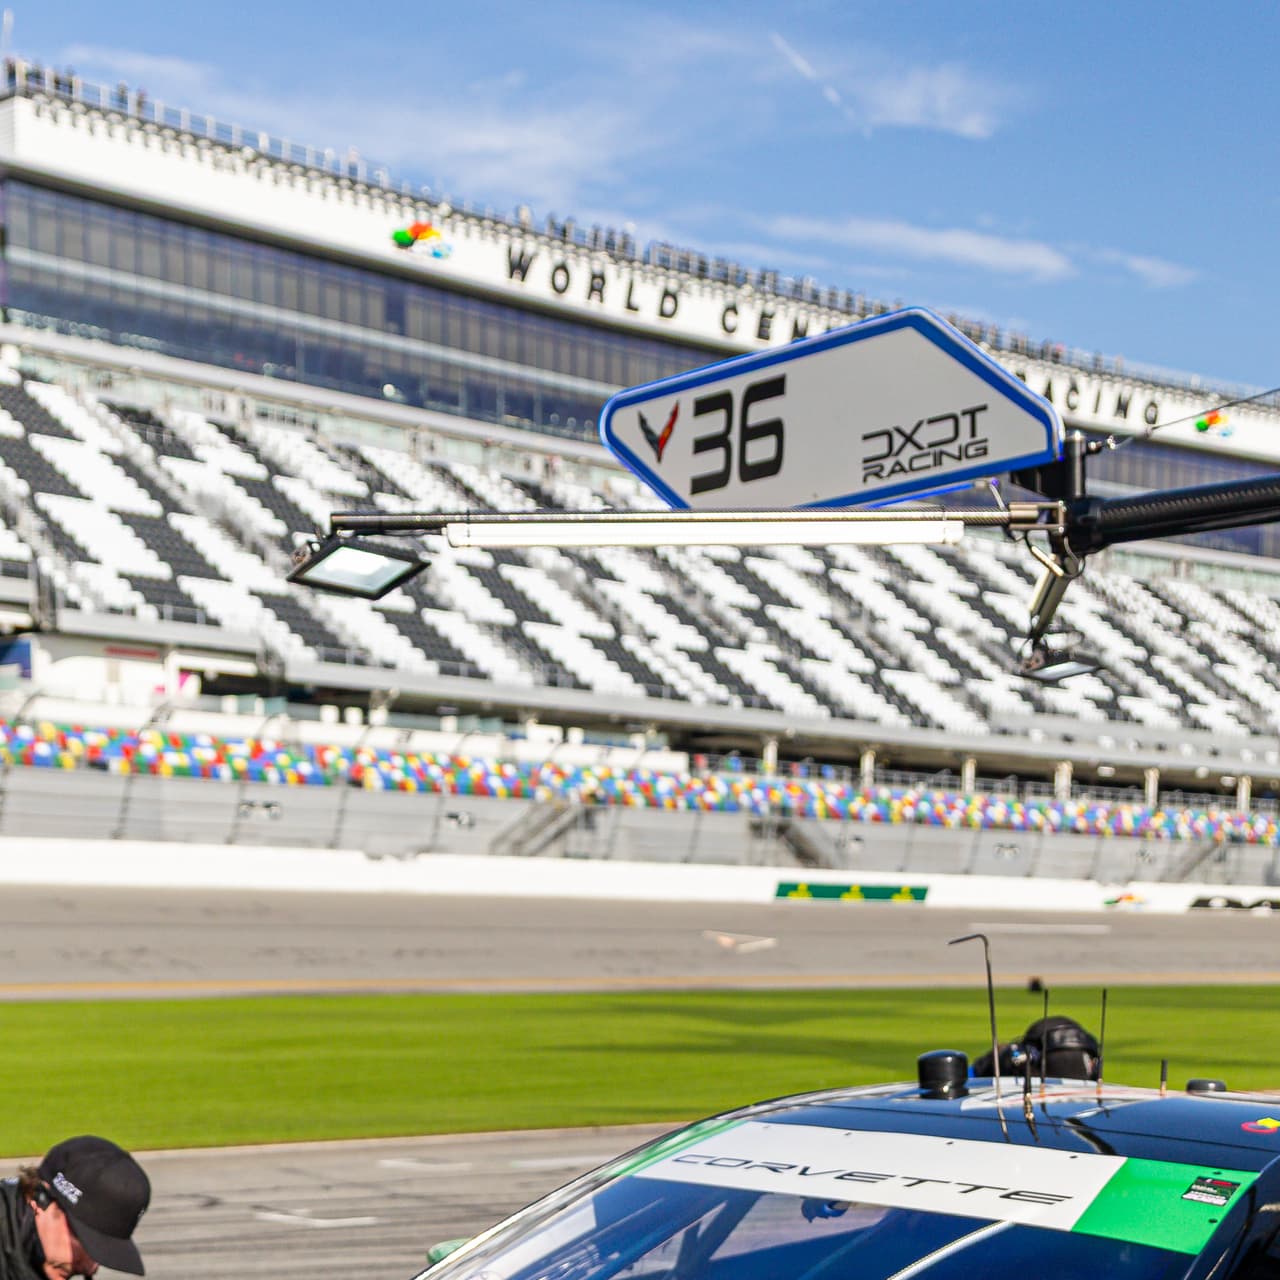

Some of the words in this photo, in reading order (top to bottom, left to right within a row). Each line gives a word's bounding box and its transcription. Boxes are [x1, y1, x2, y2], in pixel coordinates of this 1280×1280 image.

[508, 247, 677, 319] WORLD
[690, 373, 786, 495] 36
[861, 403, 988, 463] DXDT
[862, 438, 988, 483] RACING
[672, 1153, 1073, 1205] CORVETTE
